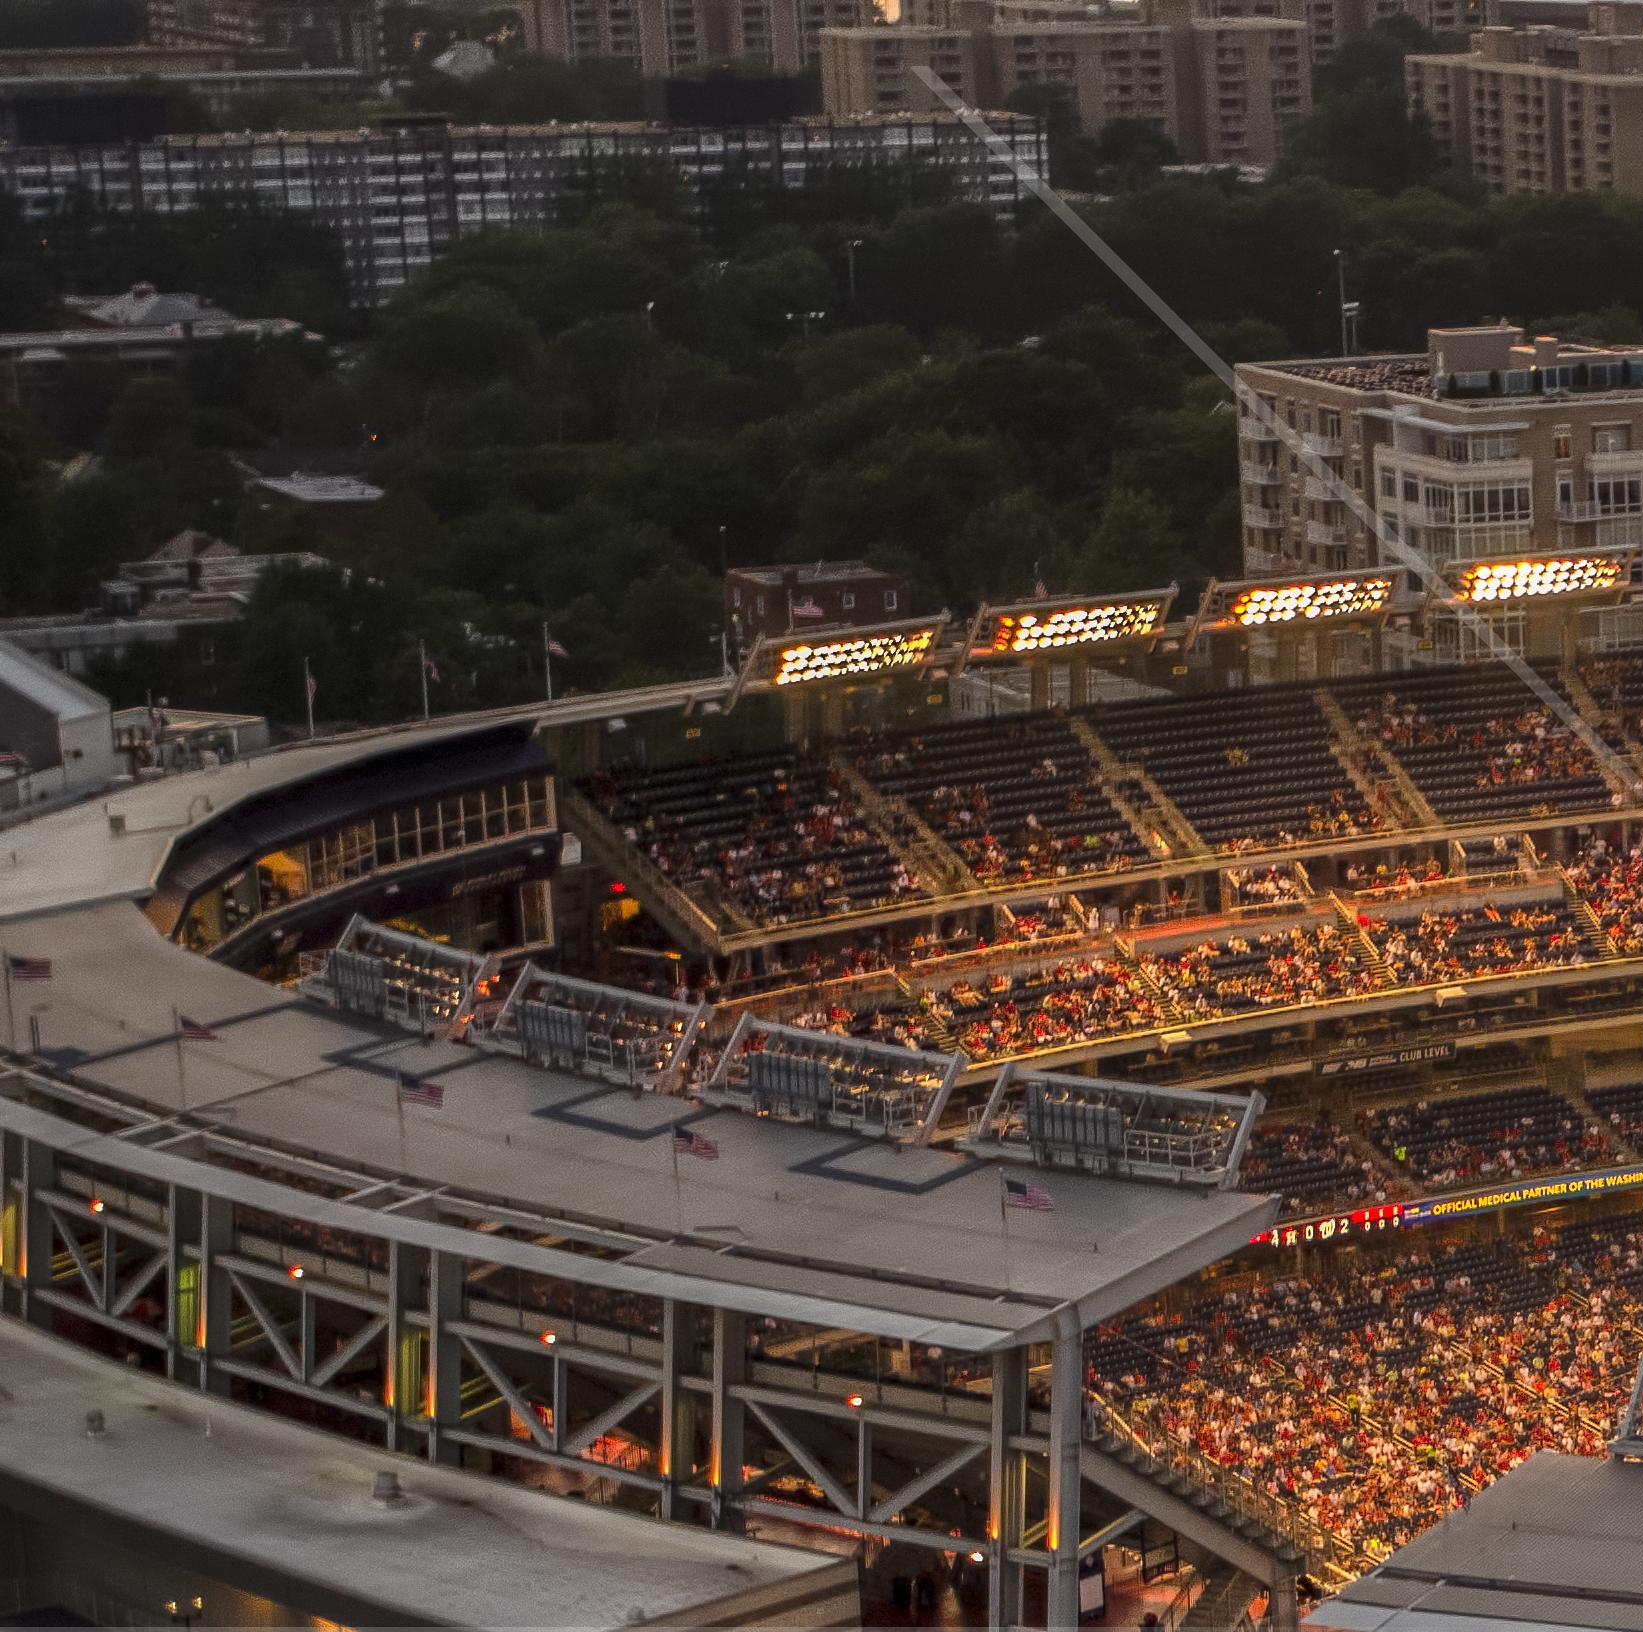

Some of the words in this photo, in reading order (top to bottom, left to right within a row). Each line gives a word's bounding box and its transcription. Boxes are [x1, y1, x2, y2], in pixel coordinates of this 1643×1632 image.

[1400, 1050, 1422, 1062] CLUB
[1424, 1045, 1450, 1059] LEVEL
[1433, 1198, 1477, 1215] OFFICIAL
[1478, 1190, 1521, 1207] MEDICAL
[1522, 1183, 1567, 1199] PARTNER
[1569, 1180, 1584, 1192] OF
[1585, 1177, 1604, 1190] THE
[1305, 1225, 1314, 1241] 0
[1340, 1218, 1349, 1234] 2
